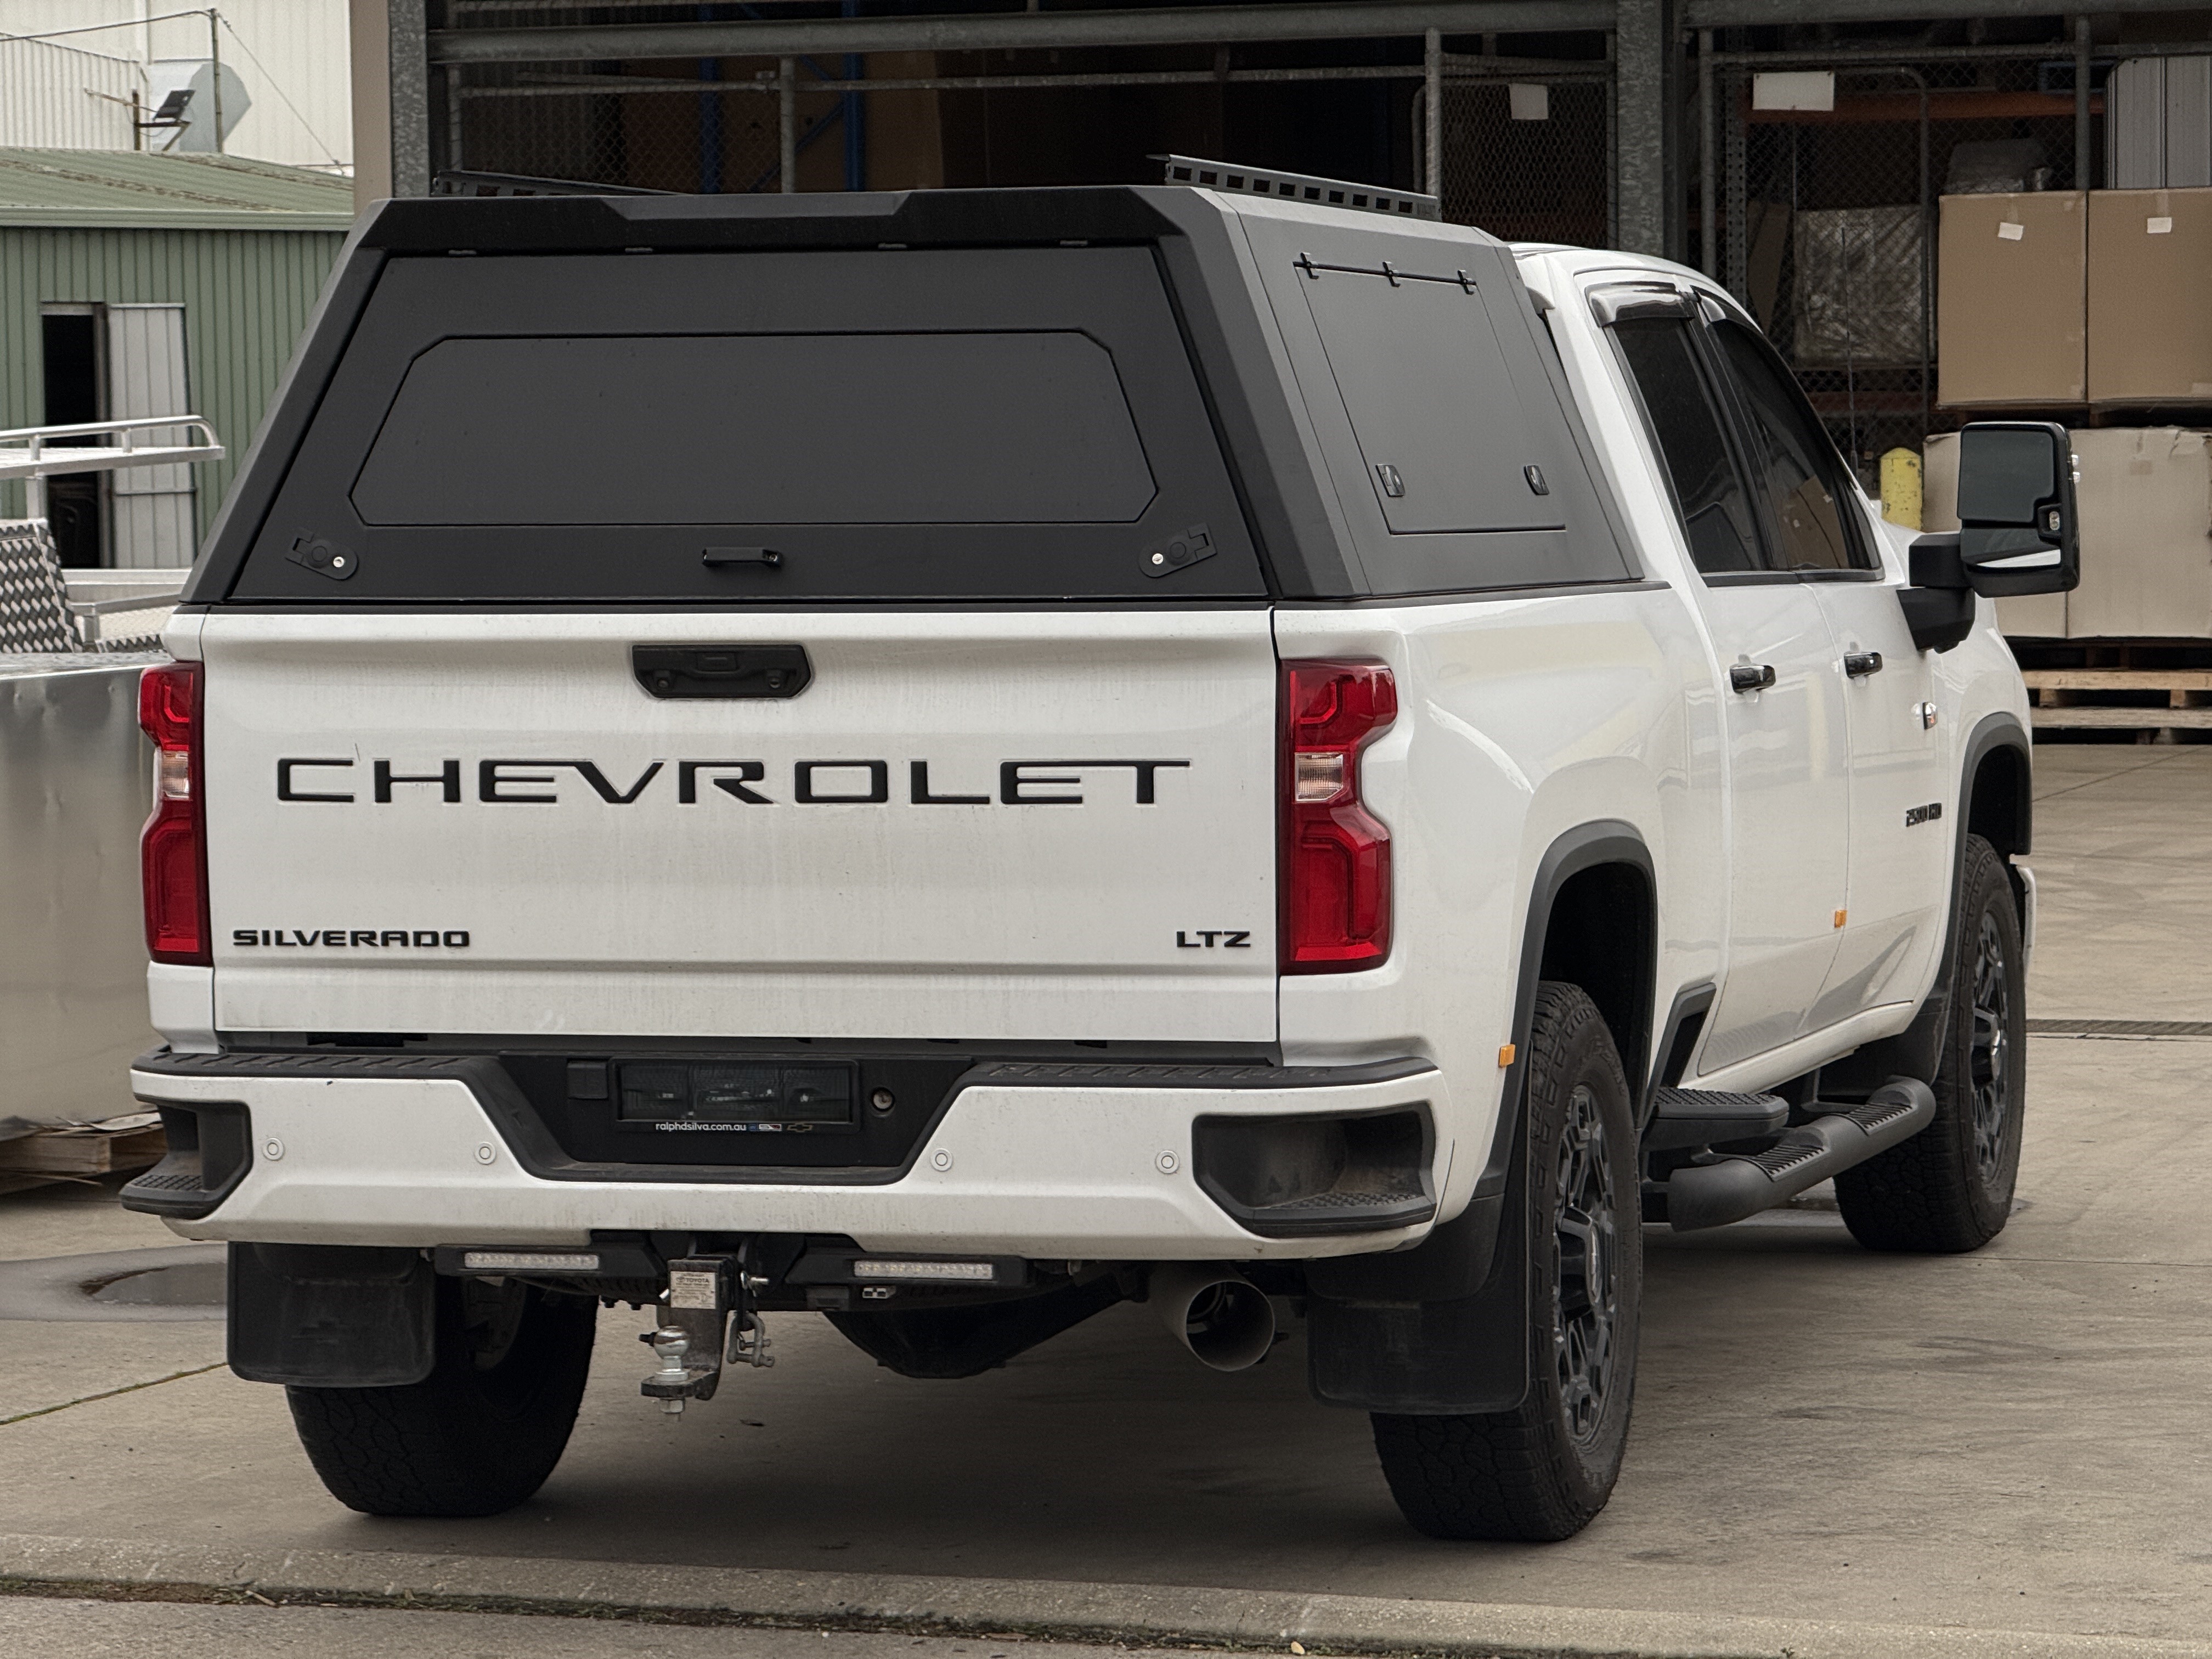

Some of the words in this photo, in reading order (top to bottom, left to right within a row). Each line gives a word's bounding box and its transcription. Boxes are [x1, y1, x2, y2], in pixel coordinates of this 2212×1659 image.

[277, 758, 1190, 805] CHEVROLET
[233, 930, 470, 947] SILVERADO
[1176, 931, 1251, 948] LTZ
[656, 1122, 747, 1132] ralphdsilva.com.au
